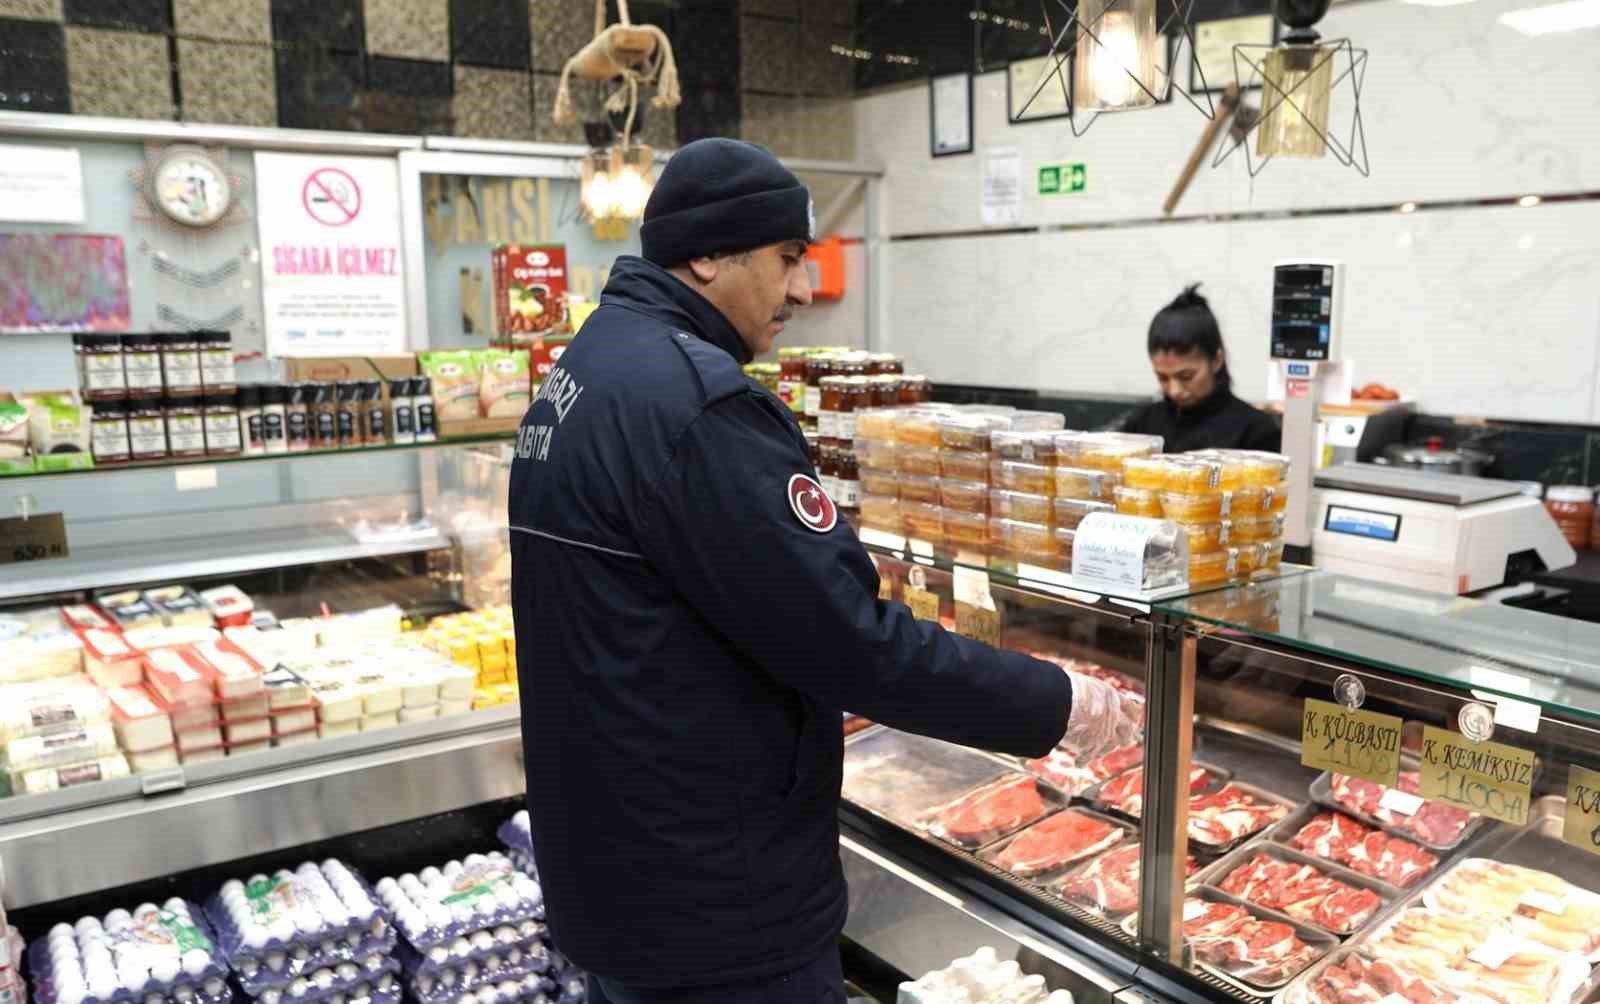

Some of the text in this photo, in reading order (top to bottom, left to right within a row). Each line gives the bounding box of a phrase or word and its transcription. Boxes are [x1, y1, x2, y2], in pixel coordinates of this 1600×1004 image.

[1306, 711, 1319, 739] K.
[1424, 739, 1532, 786] K. KEMİKSİZ
